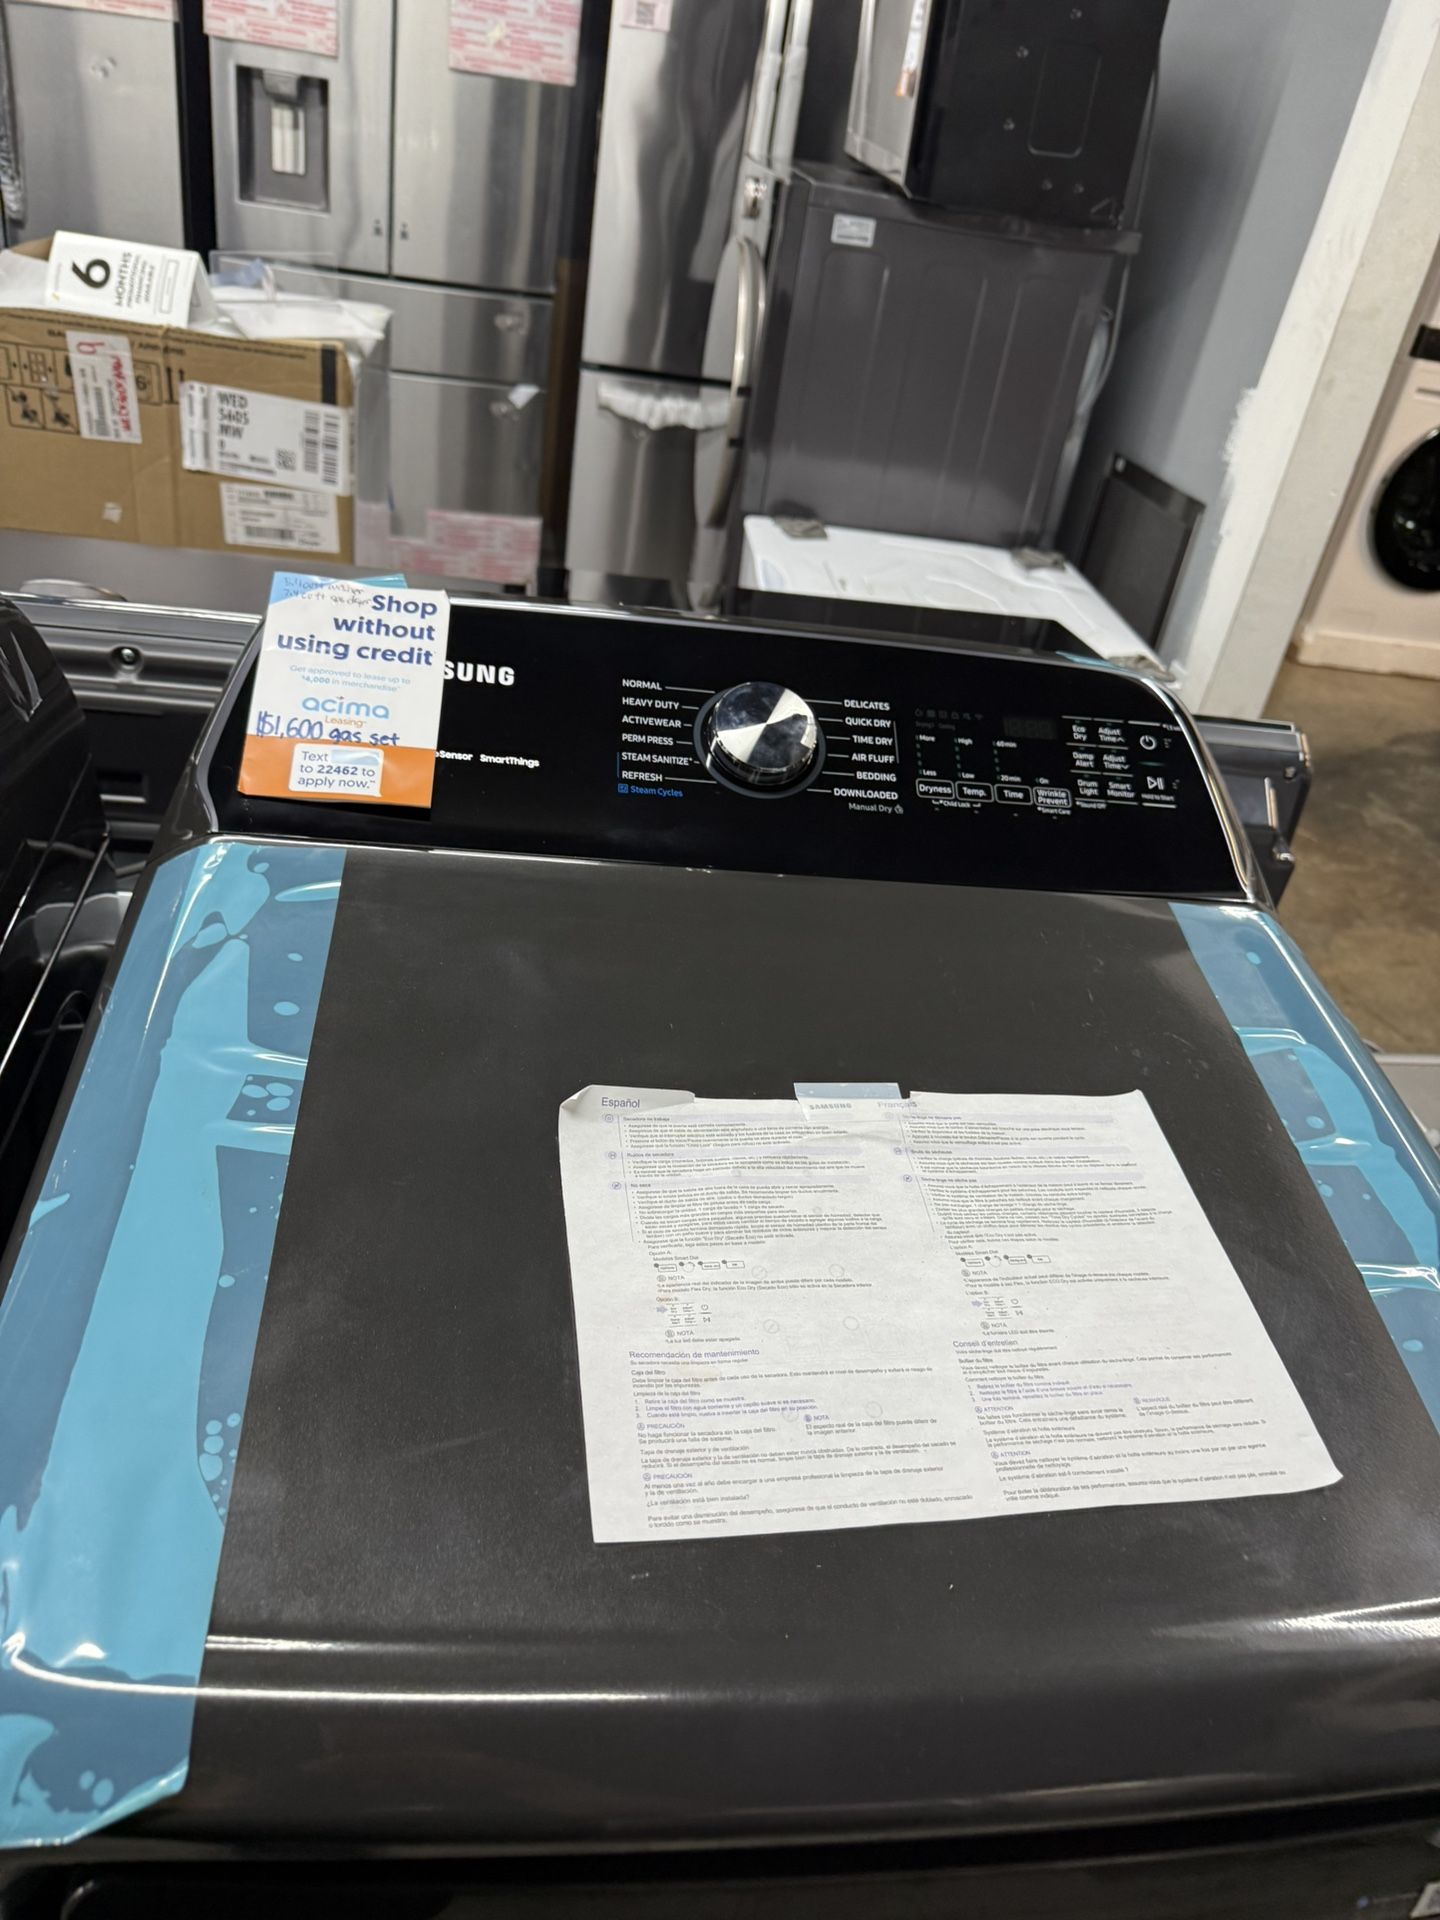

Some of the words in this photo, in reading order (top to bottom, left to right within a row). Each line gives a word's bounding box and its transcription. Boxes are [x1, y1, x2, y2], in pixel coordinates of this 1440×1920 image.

[72, 258, 110, 289] 6
[115, 251, 133, 307] MONTHS
[372, 594, 438, 619] Shop
[333, 616, 436, 641] without
[277, 634, 350, 661] using
[356, 647, 434, 667] credit
[289, 664, 306, 673] Get
[308, 666, 351, 678] approved
[364, 673, 386, 682] lease
[388, 676, 399, 685] up
[443, 659, 516, 686] SUNG
[622, 679, 663, 691] NORMAL
[302, 695, 390, 719] acima
[622, 697, 653, 708] HEAVY
[654, 699, 680, 710] DUTY
[844, 699, 891, 711] DELICATES
[621, 715, 682, 728] ACTIVEWEAR
[845, 716, 873, 727] QUICK
[873, 719, 892, 729] DRY
[1072, 724, 1087, 733] Eco
[1098, 727, 1121, 736] Adjust
[329, 728, 362, 744] gas
[369, 733, 400, 746] set
[621, 733, 646, 743] PERM
[647, 735, 674, 746] PRESS
[852, 735, 874, 745] TIME
[875, 737, 893, 747] DRY
[958, 737, 973, 746] High
[1099, 734, 1117, 743] Time
[301, 751, 329, 762] Text
[480, 754, 540, 768] SmartThings
[621, 752, 651, 763] STEAM
[851, 753, 867, 763] AIR
[868, 754, 896, 764] FLUFF
[1072, 752, 1095, 761] Damp
[1103, 754, 1126, 763] Adjust
[1075, 760, 1095, 768] Alert
[1104, 761, 1122, 770] Time
[300, 764, 313, 774] to
[317, 764, 358, 776] 22462
[362, 768, 376, 777] to
[621, 770, 663, 782] REFRESH
[856, 771, 897, 782] BEDDING
[922, 769, 938, 777] Less
[297, 775, 335, 788] apply
[1077, 779, 1099, 788] Drum
[1108, 781, 1132, 790] Smart
[630, 785, 657, 795] Steam
[657, 787, 684, 798] Cycles
[833, 787, 899, 800] DOWNLOADED
[918, 783, 952, 795] Dryness
[962, 786, 988, 798] Temp.
[1003, 789, 1024, 799] Time
[1037, 789, 1067, 799] Wrinkle
[1079, 787, 1099, 797] Light
[1107, 789, 1135, 798] Monitor
[848, 802, 877, 812] Manual
[878, 804, 893, 814] Dry
[601, 1097, 640, 1109] Español
[809, 1102, 852, 1110] SAMSUNG
[953, 1340, 980, 1348] Conseil
[629, 1350, 691, 1359] Recomendación
[692, 1351, 702, 1359] de
[703, 1349, 760, 1359] mantenimiento
[646, 1422, 685, 1430] PRECAUCIÓN
[653, 1472, 693, 1480] PRECAUCIÓN
